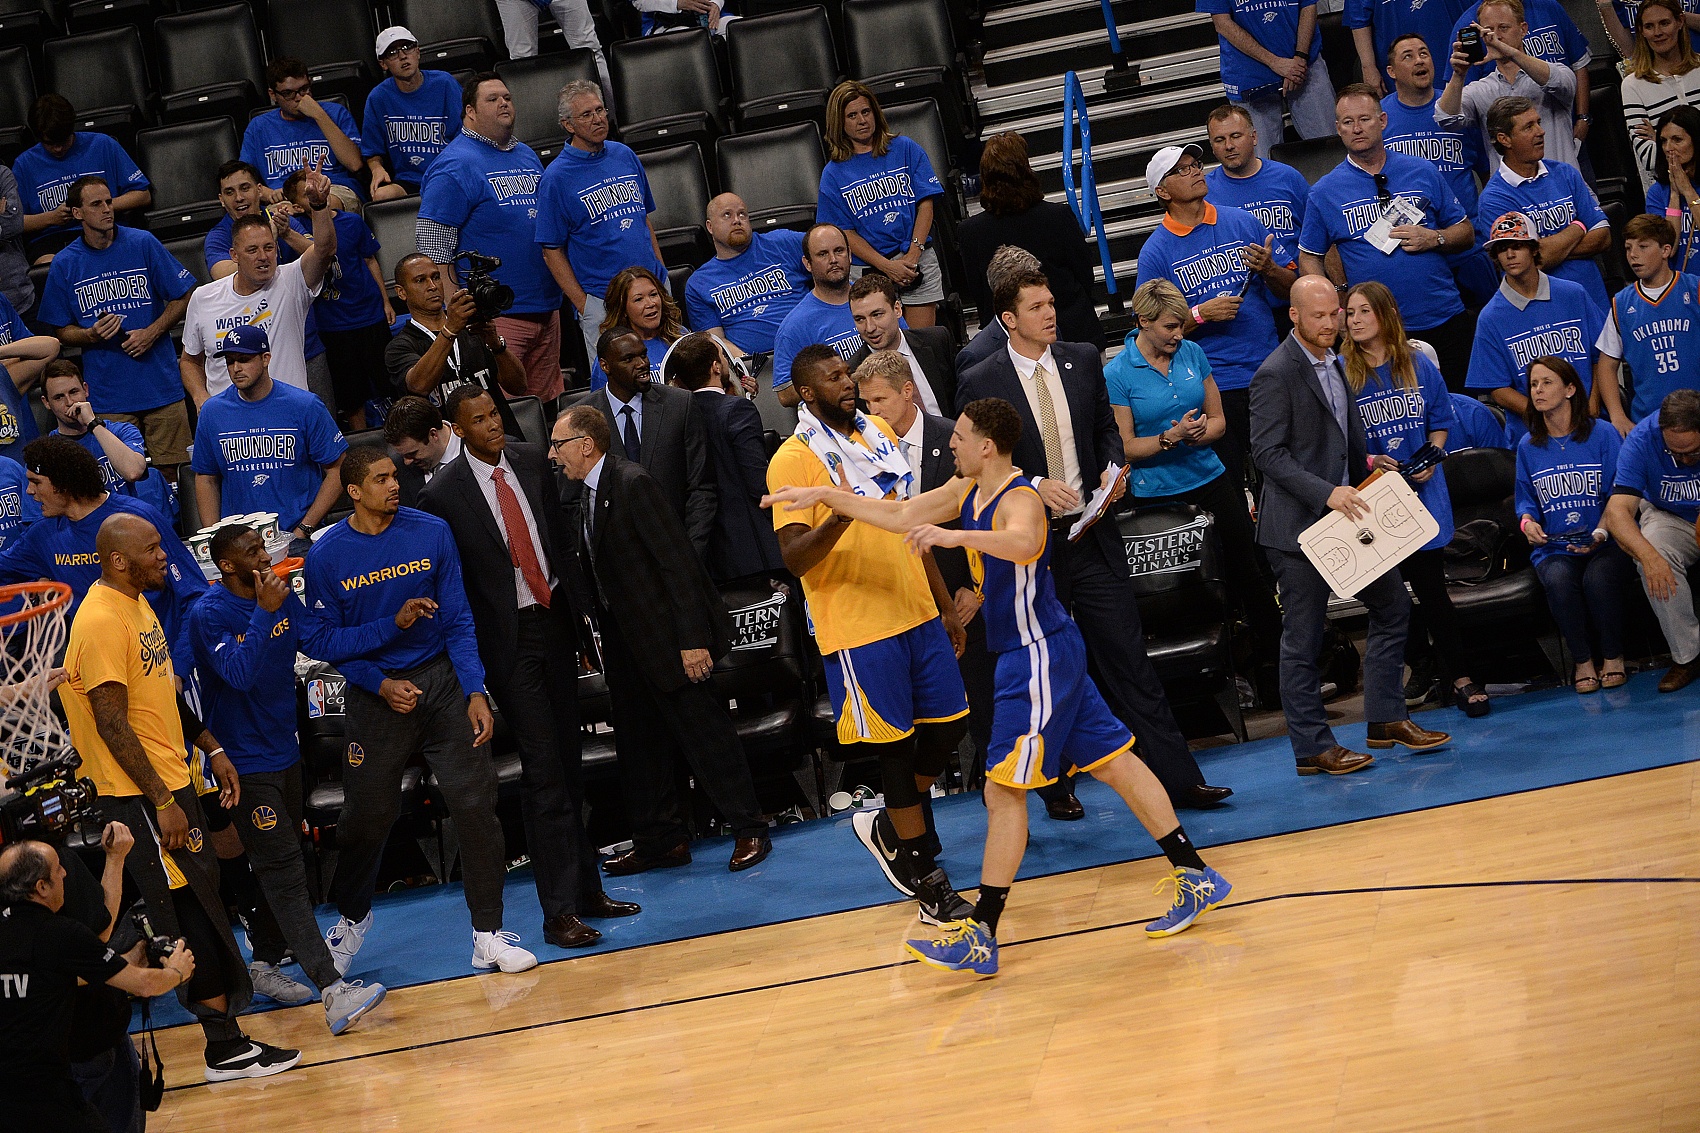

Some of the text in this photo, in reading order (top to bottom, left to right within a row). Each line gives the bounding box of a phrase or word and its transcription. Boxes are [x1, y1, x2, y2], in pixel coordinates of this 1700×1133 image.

[842, 172, 916, 216] THUNDER
[74, 274, 151, 313] THUNDER
[711, 267, 793, 314] THUNDER
[1632, 319, 1690, 342] OKLAHOMA
[1651, 336, 1676, 351] CITY
[1655, 350, 1680, 374] 35
[220, 434, 296, 465] THUNDER
[236, 462, 283, 472] BASKETBALL
[1127, 541, 1203, 565] ONFERENCE
[1132, 554, 1190, 574] FINALS
[341, 558, 431, 591] WARRIORS
[0, 973, 29, 998] TV
